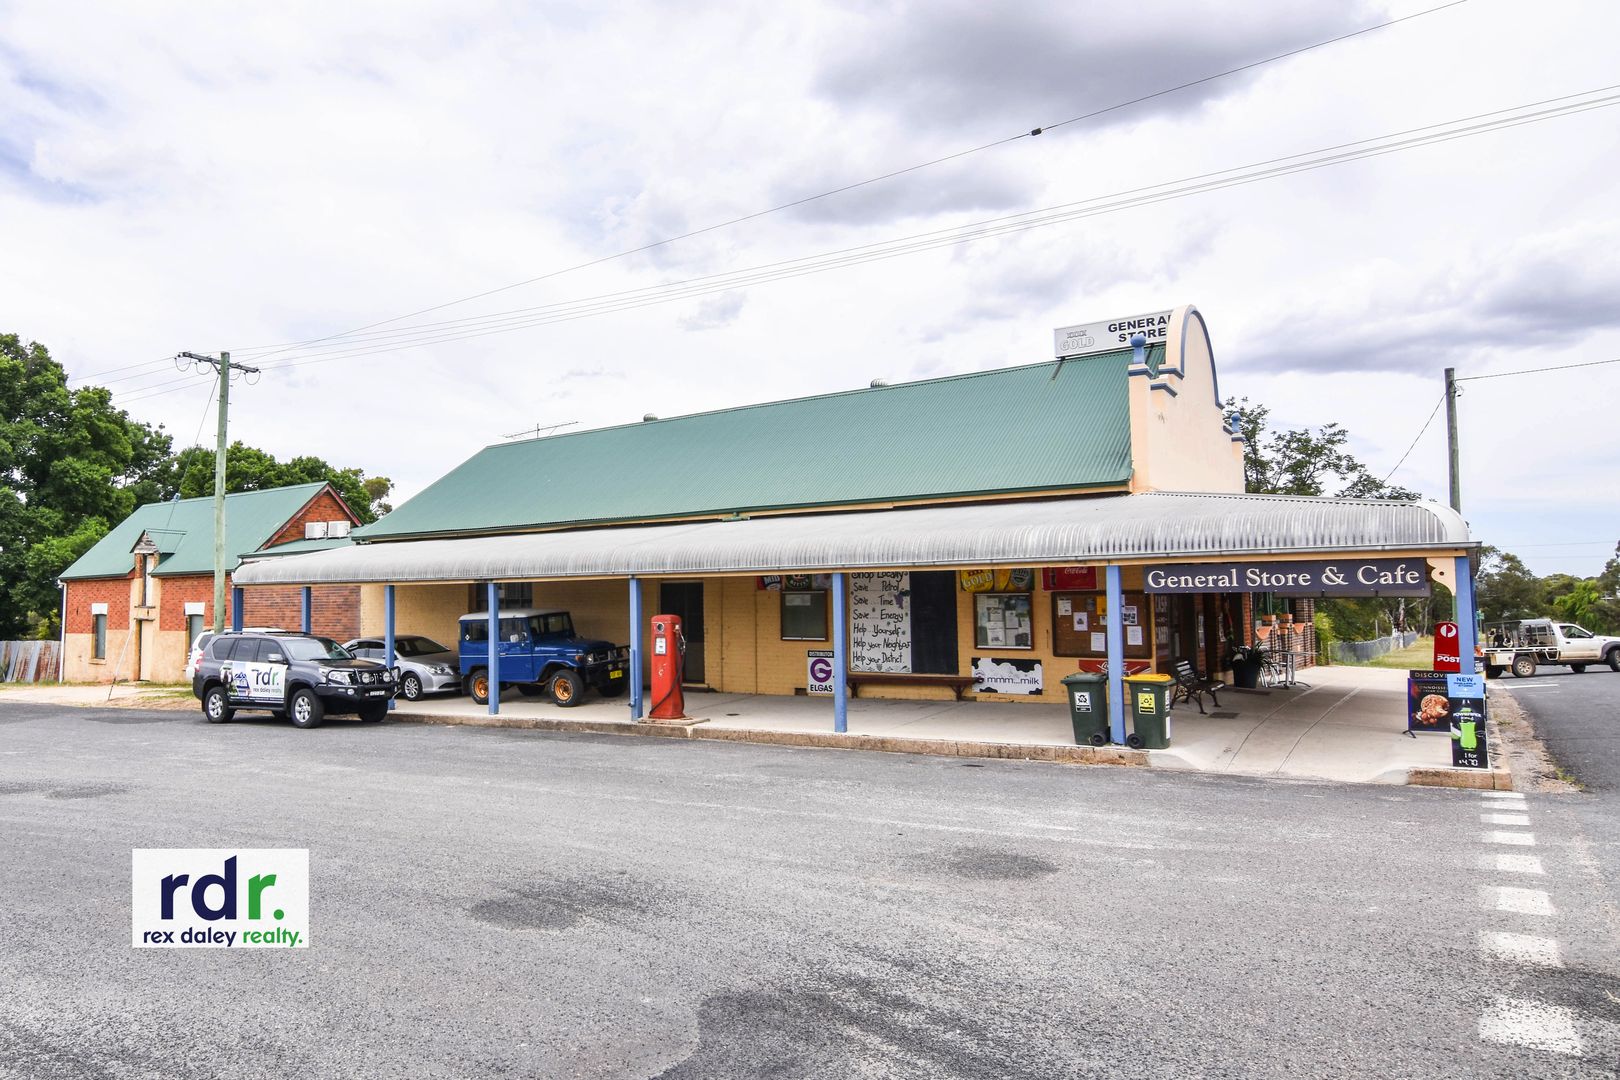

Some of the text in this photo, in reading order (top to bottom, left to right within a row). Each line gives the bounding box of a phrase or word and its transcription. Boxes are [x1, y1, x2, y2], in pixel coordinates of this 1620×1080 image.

[1060, 336, 1094, 351] GOLD
[1148, 565, 1420, 588] General Store & Cafe
[853, 580, 899, 592] Save Petrol
[853, 595, 894, 606] Save Time
[853, 608, 904, 623] Save Energy
[853, 623, 867, 636] Help
[853, 637, 866, 651] Help
[853, 651, 866, 665] Help
[1437, 655, 1460, 663] POST
[810, 684, 833, 693] ELGAS
